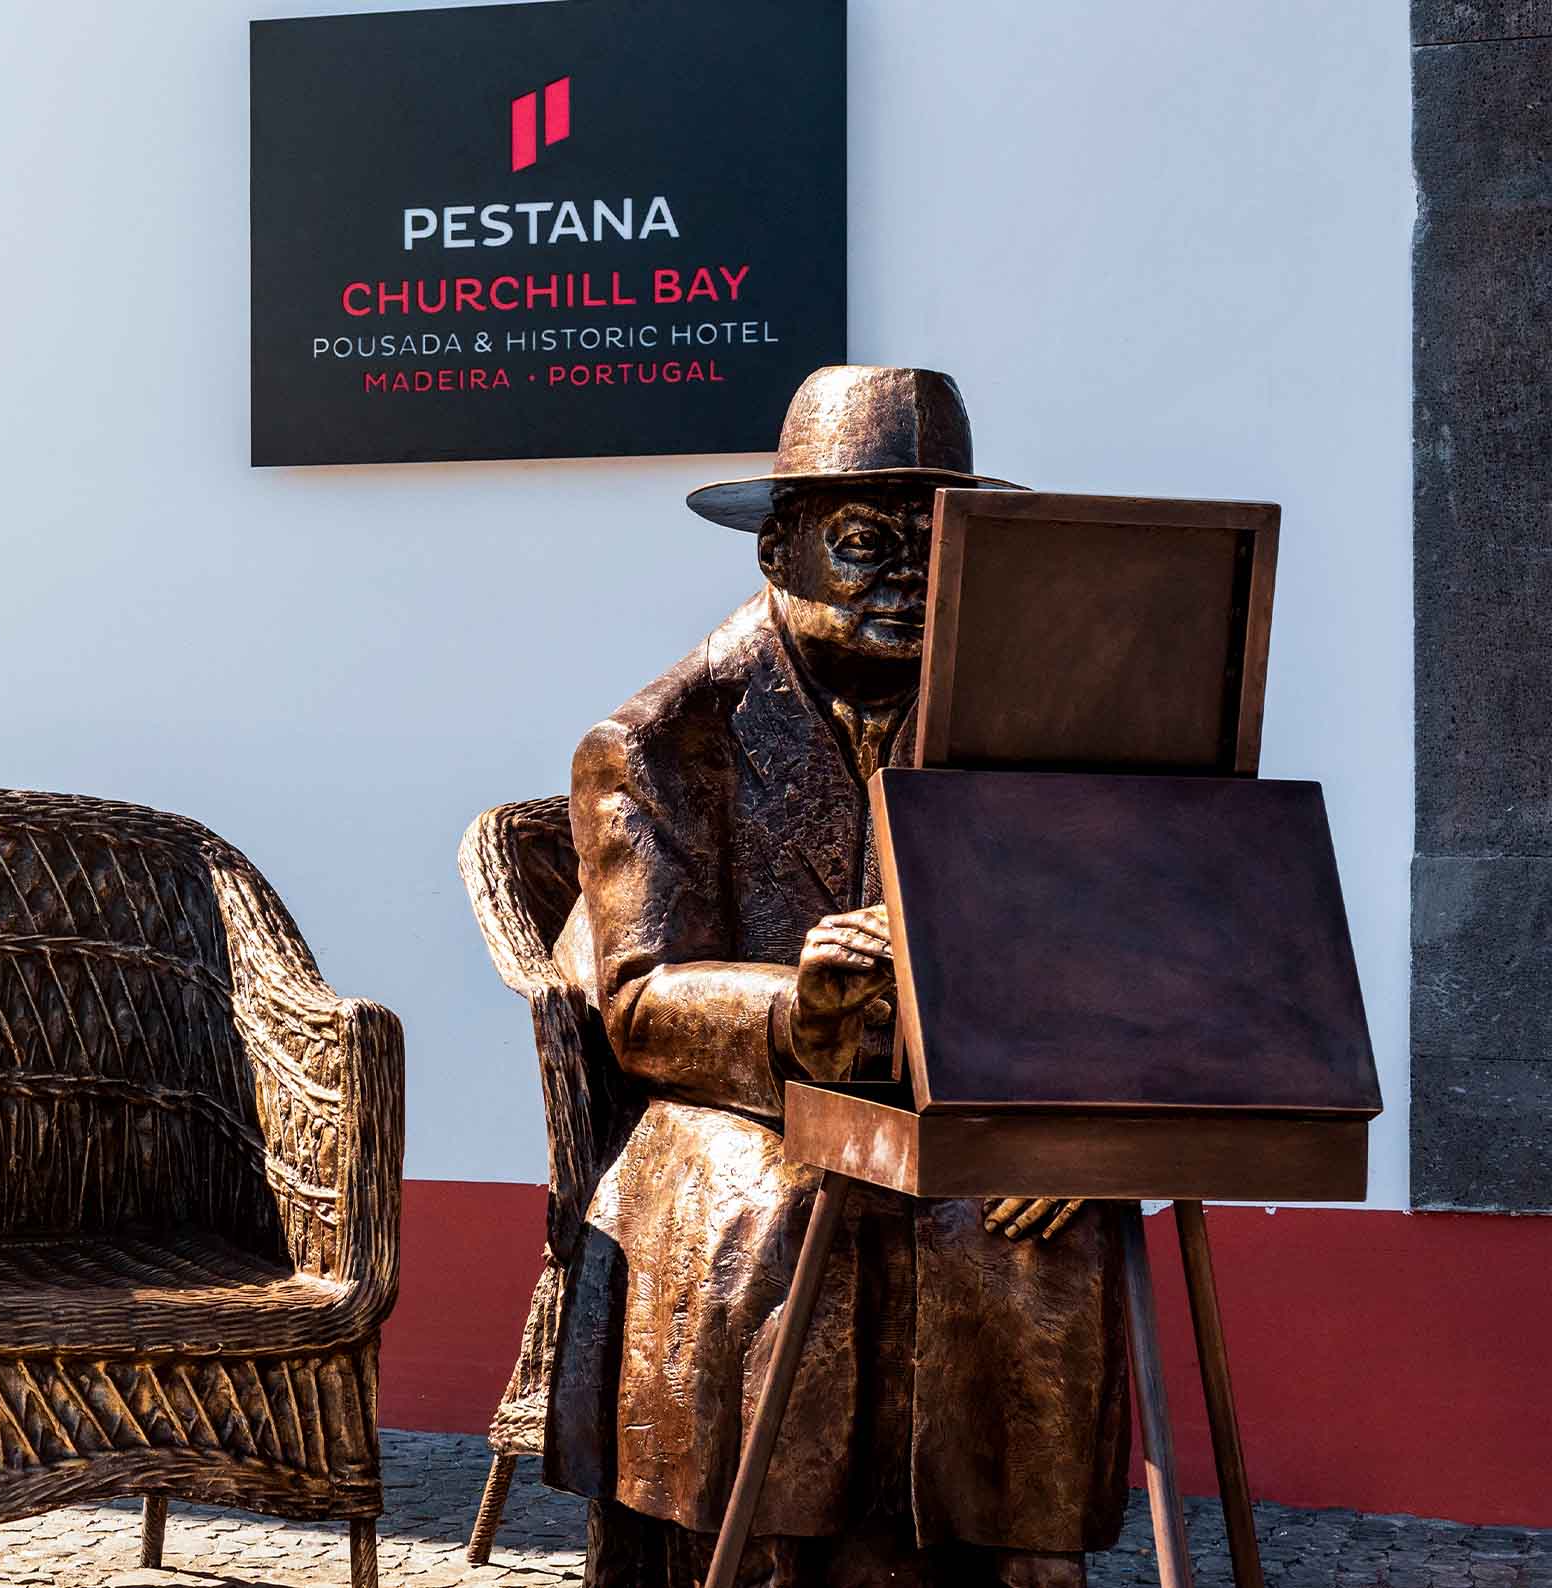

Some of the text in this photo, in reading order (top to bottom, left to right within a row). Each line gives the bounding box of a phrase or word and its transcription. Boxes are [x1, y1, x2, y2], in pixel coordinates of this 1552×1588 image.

[403, 197, 680, 250] PESTANA
[342, 265, 749, 317] CHURCHILL BAY
[313, 320, 779, 359] POUSADA & HISTORIC HOTEL
[365, 360, 724, 393] MADEIRA PORTUGAL
